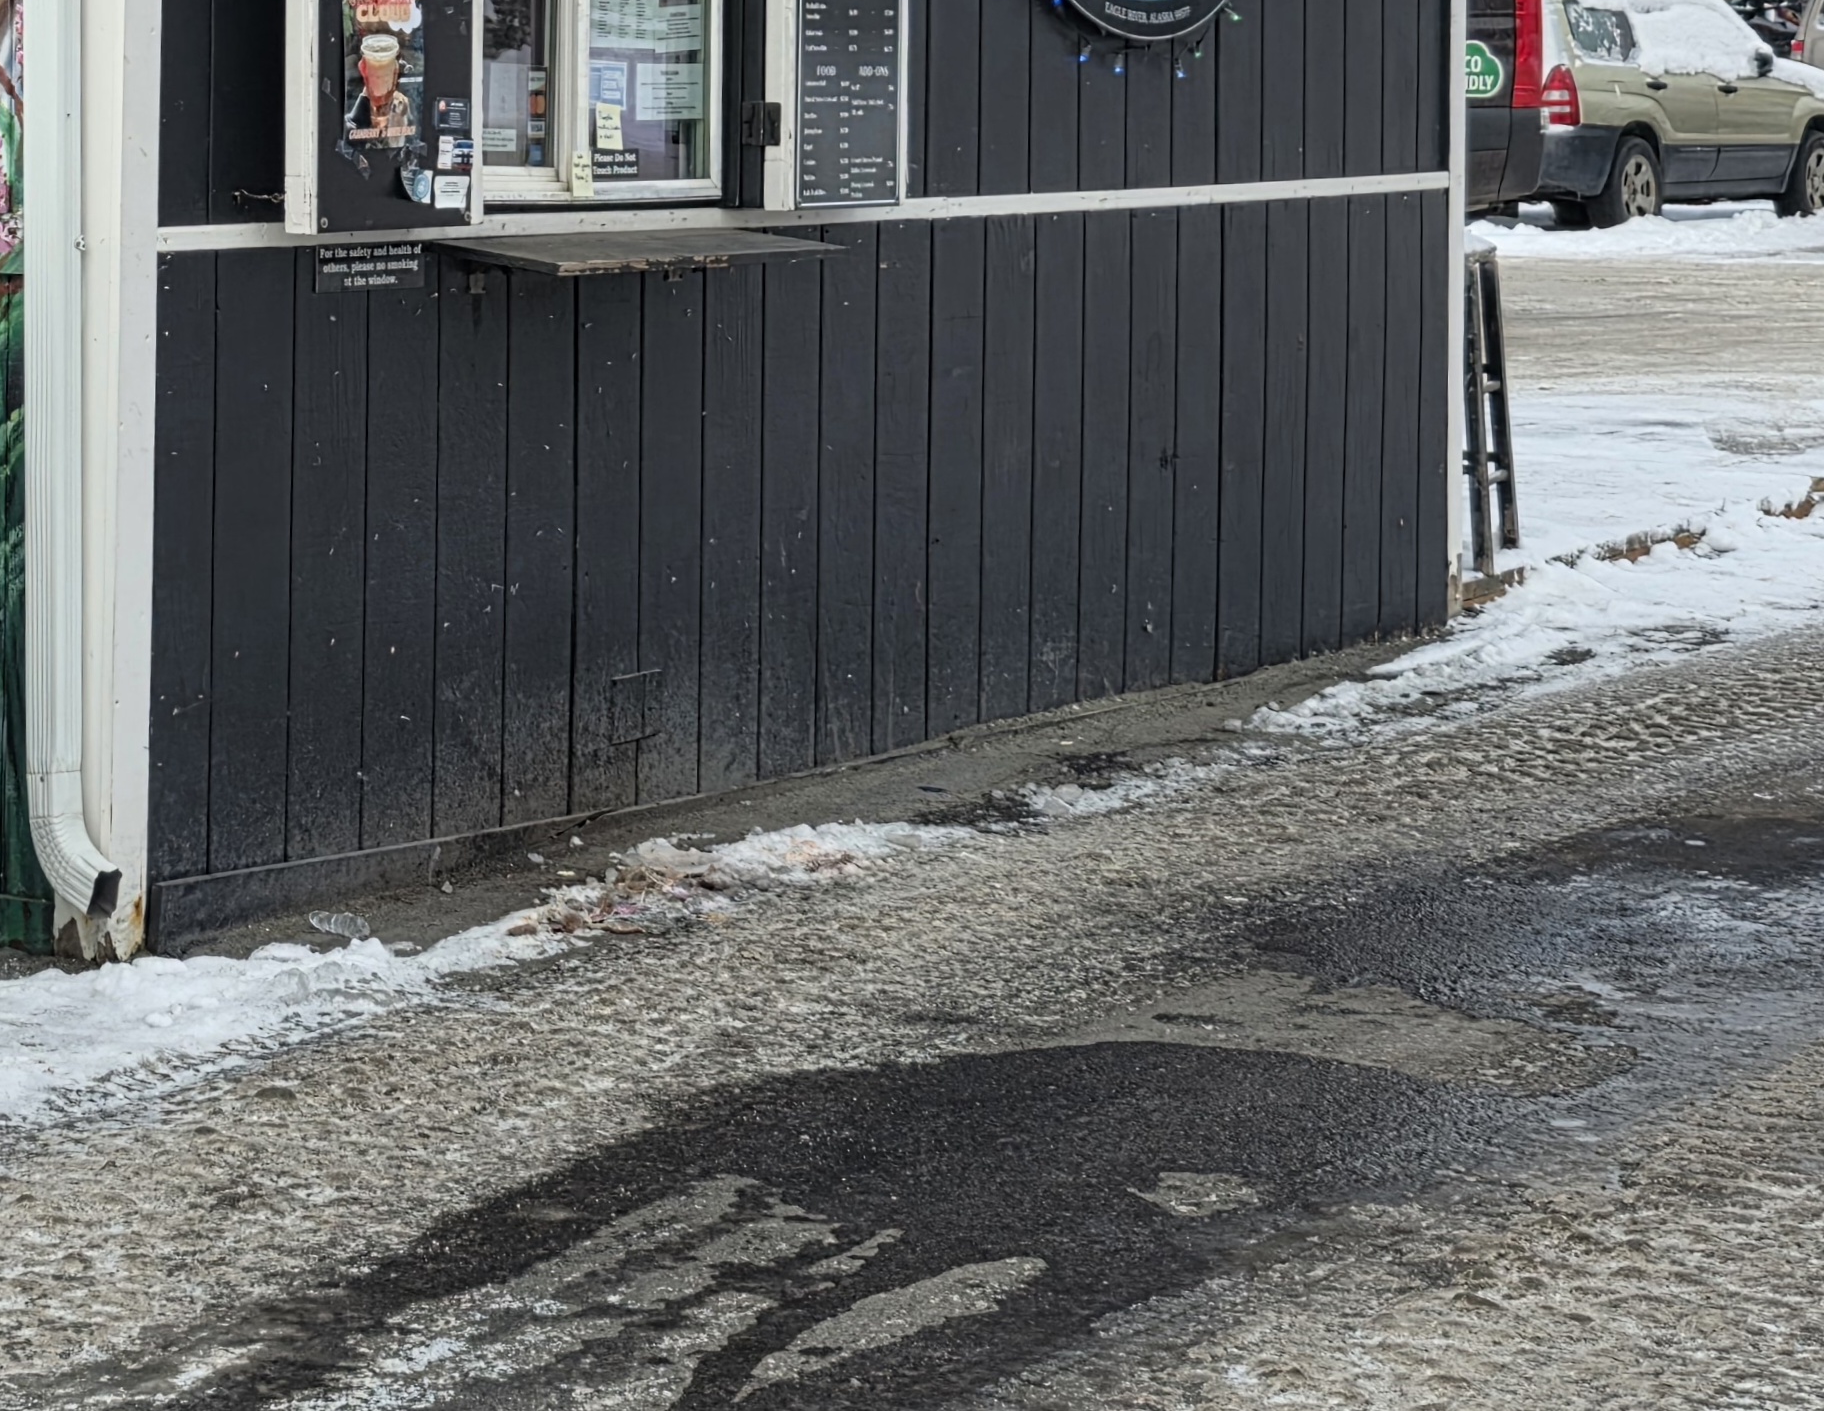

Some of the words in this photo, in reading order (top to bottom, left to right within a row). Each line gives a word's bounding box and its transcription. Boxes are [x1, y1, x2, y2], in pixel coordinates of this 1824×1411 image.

[356, 4, 411, 22] CLOUD
[320, 248, 333, 259] For
[335, 248, 347, 257] the
[349, 247, 371, 258] safety
[373, 245, 387, 256] and
[389, 244, 411, 255] health
[413, 243, 422, 254] of
[323, 262, 349, 273] others,
[351, 261, 374, 274] please
[376, 262, 386, 270] no
[387, 259, 418, 271] smoking
[344, 277, 352, 286] at
[354, 276, 366, 286] the
[368, 274, 398, 285] window.
